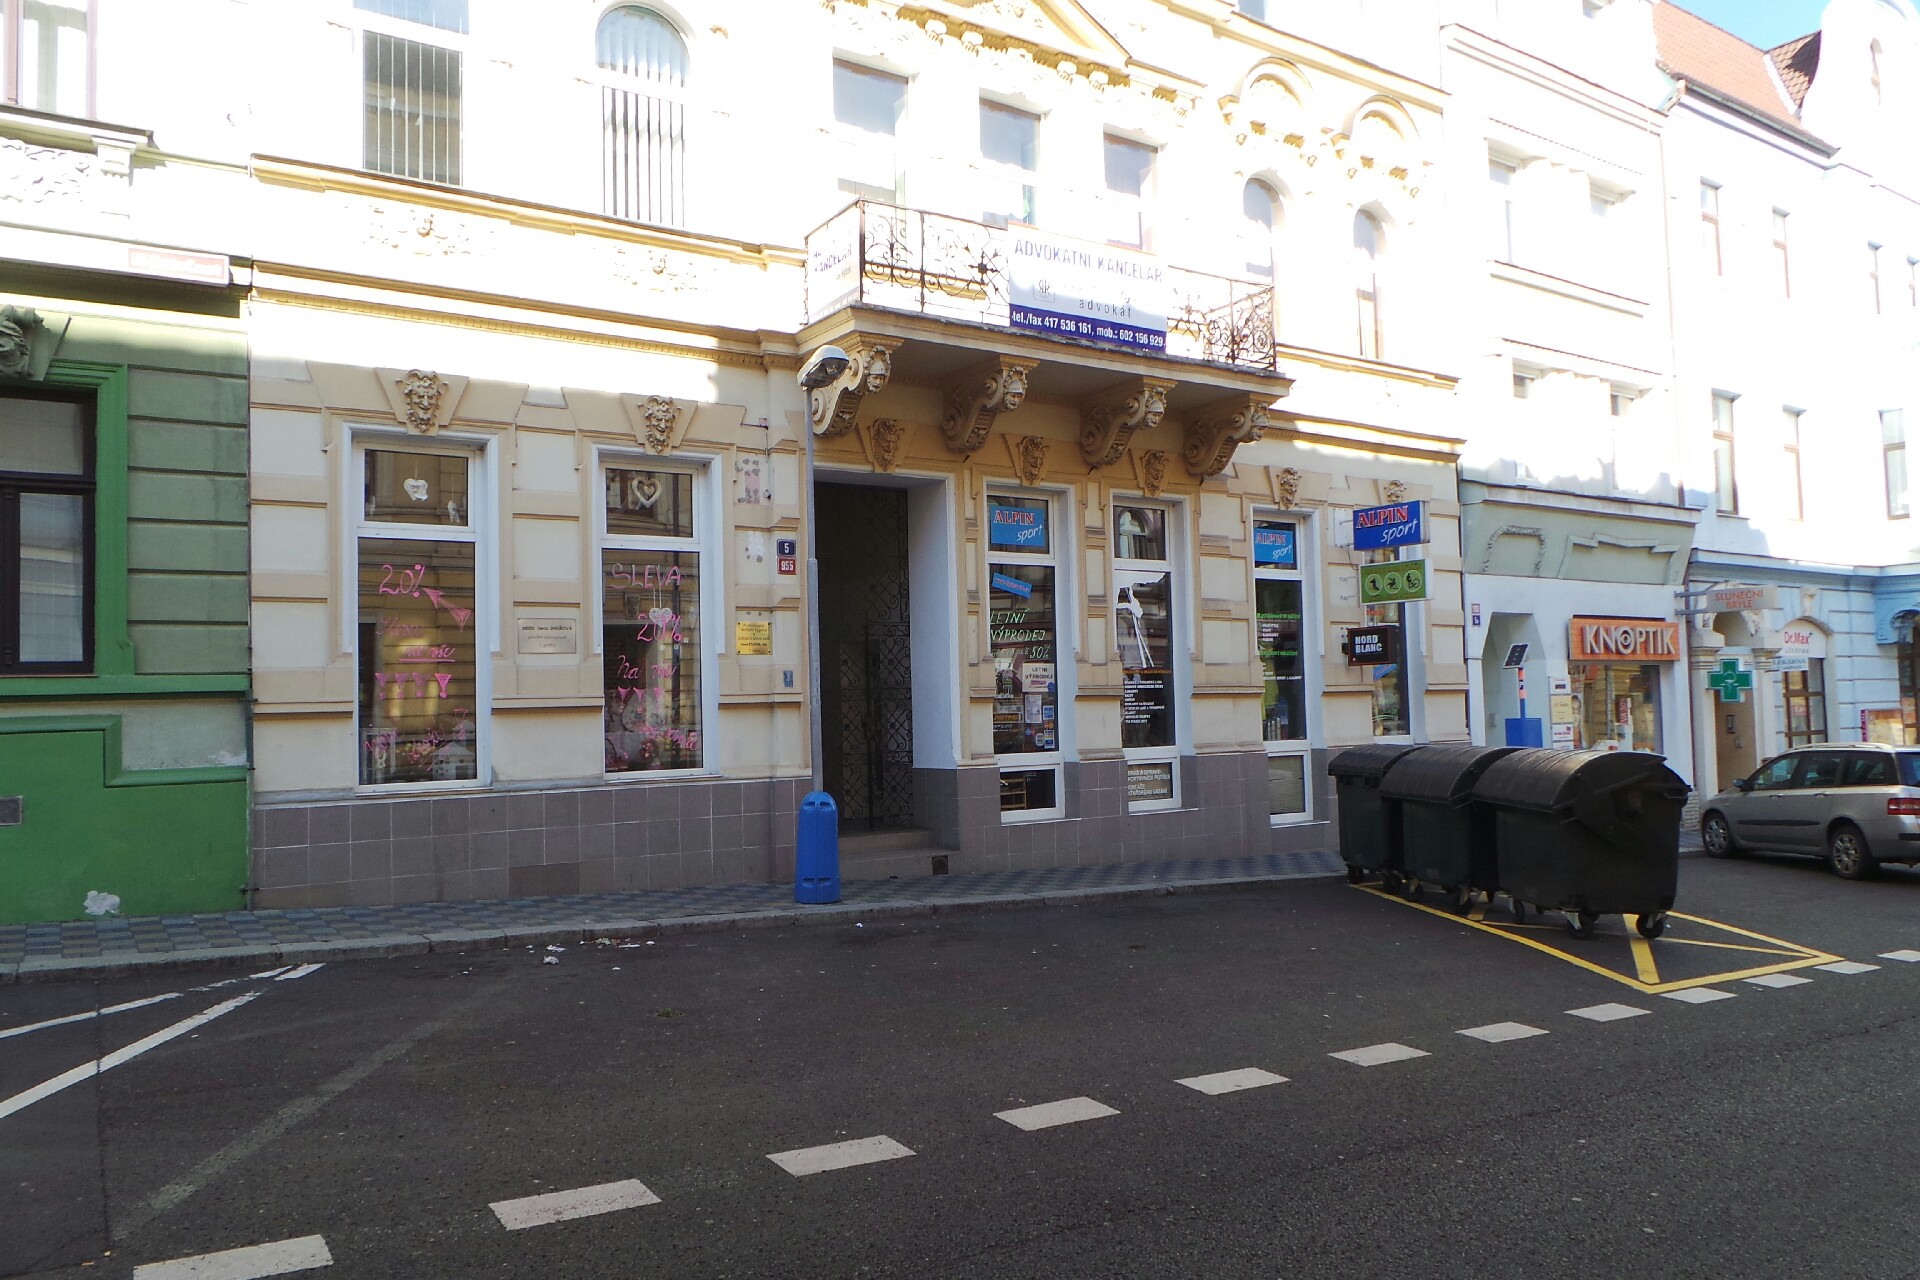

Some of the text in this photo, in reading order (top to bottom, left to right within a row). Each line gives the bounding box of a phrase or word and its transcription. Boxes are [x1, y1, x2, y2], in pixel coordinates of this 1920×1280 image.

[1079, 298, 1132, 318] advokát
[1044, 315, 1058, 328] 417
[1060, 318, 1075, 331] 536
[1135, 331, 1149, 345] 156
[993, 510, 1034, 525] ALPIN
[1355, 505, 1408, 529] ALPIN
[1016, 524, 1043, 543] sport
[1255, 532, 1286, 545] ALPIN
[1381, 518, 1418, 545] sport
[784, 543, 790, 554] 5
[1272, 545, 1292, 560] sport
[781, 560, 794, 571] 955
[611, 562, 682, 590] SLEVA
[990, 625, 1046, 641] VÝPRODEJ
[1355, 635, 1379, 644] NORD
[1582, 625, 1676, 655] KNOPTIK
[1784, 631, 1810, 644] Dr.Max
[1029, 643, 1051, 659] 50%
[1355, 643, 1382, 653] BLANC
